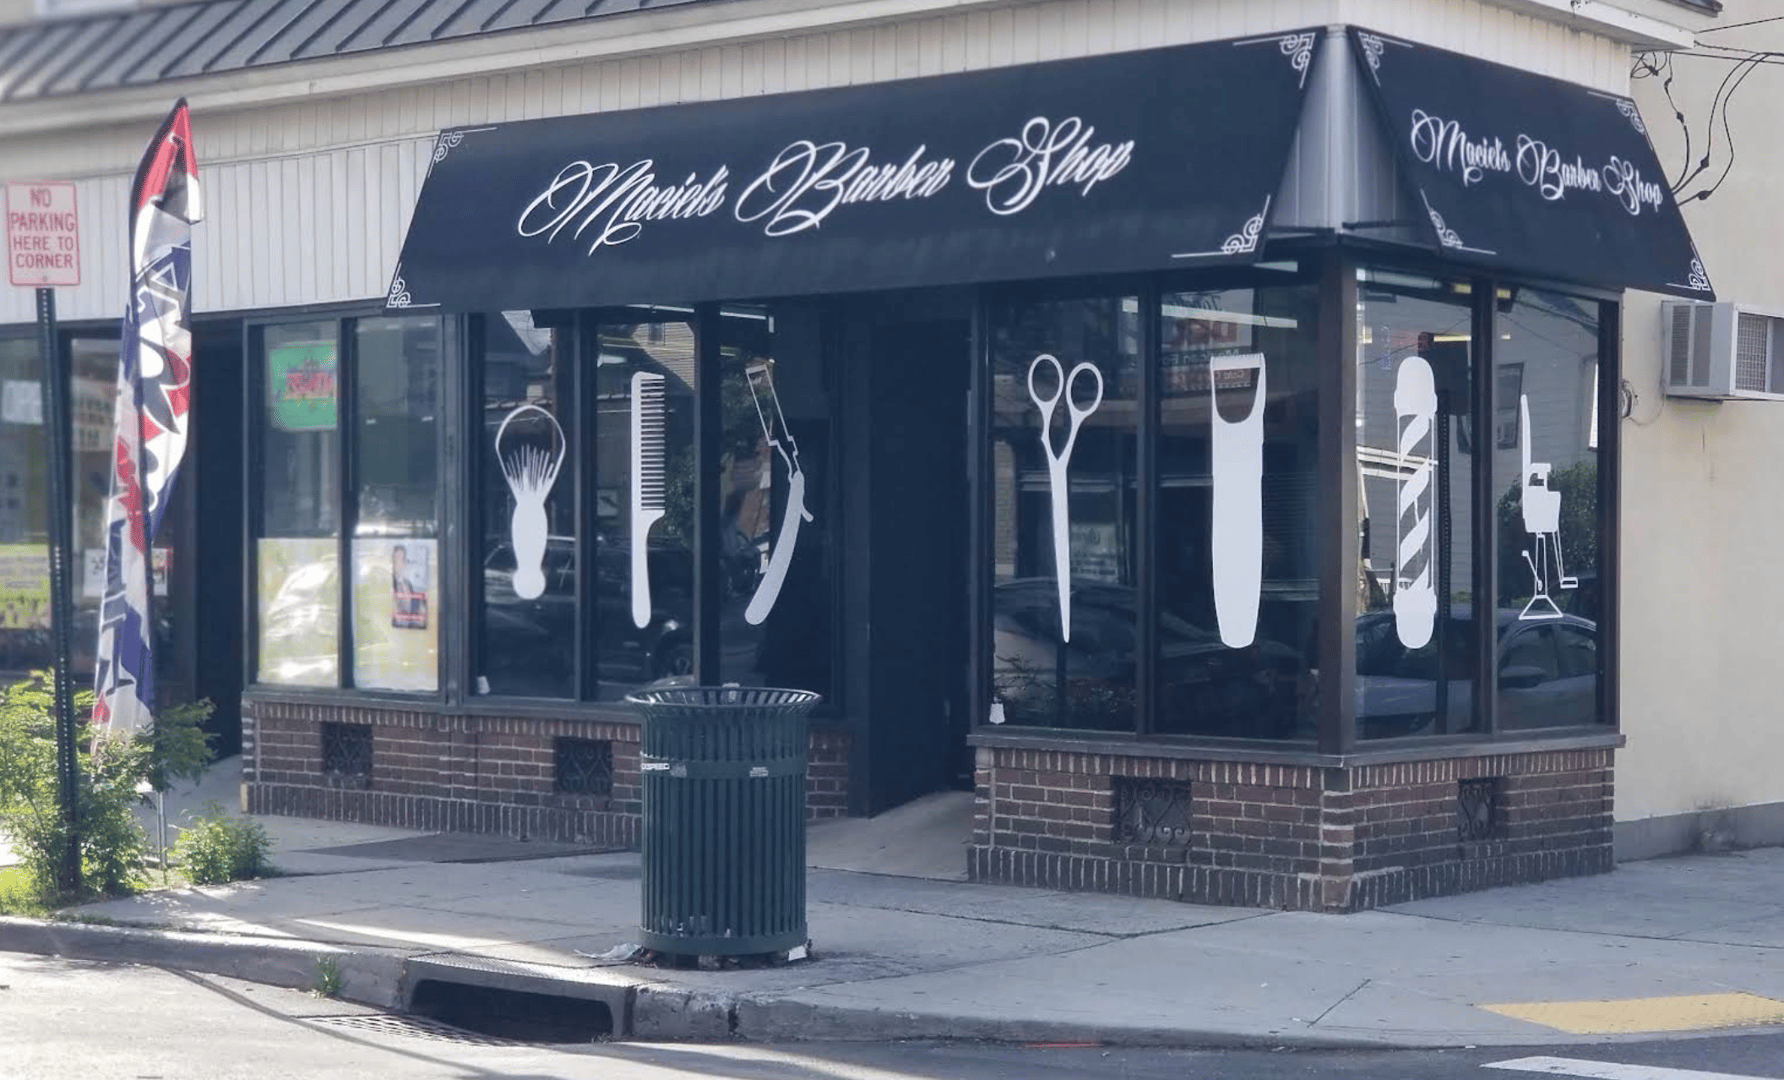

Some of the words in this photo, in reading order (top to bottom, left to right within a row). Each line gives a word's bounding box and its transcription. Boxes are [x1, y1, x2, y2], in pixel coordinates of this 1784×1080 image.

[734, 140, 955, 236] Barber
[966, 116, 1135, 215] Shop
[1516, 134, 1601, 200] Barber
[1603, 155, 1663, 215] Shop
[30, 188, 52, 208] NO
[10, 212, 75, 232] PARKING
[13, 236, 51, 251] HERE
[57, 236, 74, 251] TO
[16, 253, 73, 269] CORNER
